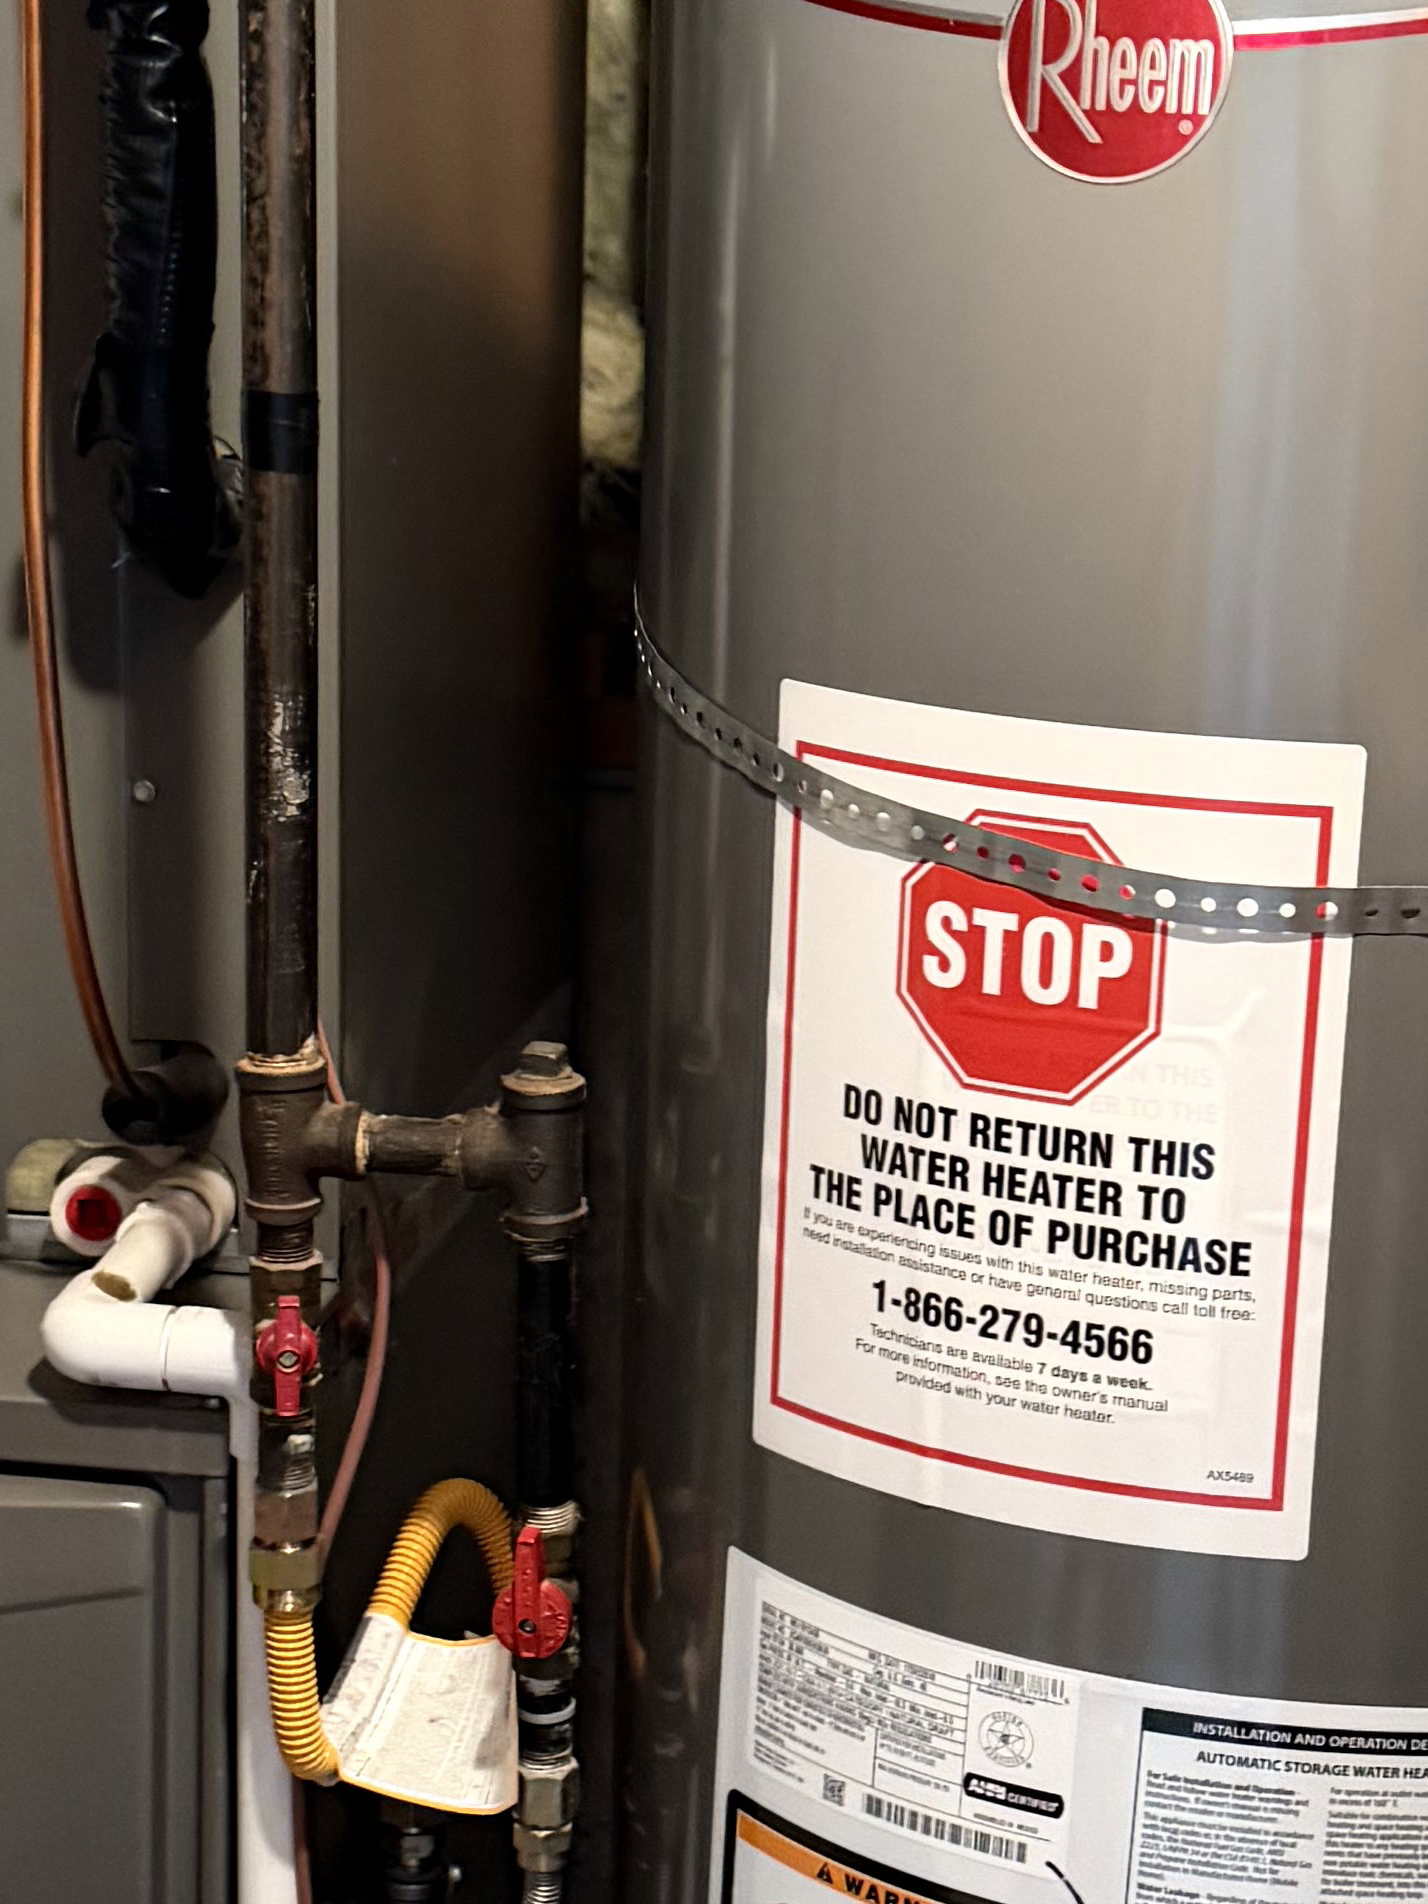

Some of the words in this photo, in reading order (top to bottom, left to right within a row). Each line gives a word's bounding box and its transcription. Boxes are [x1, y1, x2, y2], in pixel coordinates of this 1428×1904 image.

[921, 899, 1133, 1011] STOP
[844, 1084, 882, 1125] DO
[894, 1096, 957, 1142] NOT
[970, 1112, 1113, 1169] RETURN
[1129, 1136, 1214, 1180] THIS
[861, 1134, 969, 1192] WATER
[983, 1162, 1121, 1217] HEATER
[1138, 1185, 1185, 1223] TO
[810, 1164, 861, 1212] THE
[874, 1184, 974, 1239] PLACE
[989, 1210, 1033, 1249] OF
[1048, 1219, 1252, 1277] PURCHASE
[814, 1211, 833, 1226] you
[836, 1219, 854, 1233] are
[858, 1225, 935, 1257] experiencing
[940, 1244, 982, 1264] issues
[986, 1255, 1013, 1270] with
[1018, 1260, 1043, 1276] this
[1049, 1268, 1088, 1283] water
[1149, 1282, 1208, 1300] missing
[833, 1234, 895, 1262] installation
[899, 1255, 966, 1280] assistance
[971, 1272, 984, 1284] or
[989, 1273, 1022, 1291] have
[1027, 1283, 1081, 1301] general
[1085, 1293, 1158, 1312] questions
[1163, 1301, 1188, 1314] call
[1194, 1304, 1215, 1317] toll
[870, 1323, 942, 1354] Technicians
[947, 1346, 968, 1361] are
[972, 1350, 1033, 1373] available
[1037, 1362, 1047, 1374] 7
[1051, 1365, 1088, 1384] days
[1092, 1372, 1101, 1384] a
[872, 1280, 1153, 1364] 1-866-279-4566
[856, 1338, 876, 1354] For
[879, 1347, 910, 1364] more
[995, 1374, 1020, 1388] see
[1025, 1378, 1048, 1394] the
[1112, 1395, 1168, 1412] manual
[896, 1370, 951, 1394] provided
[955, 1386, 982, 1401] with
[986, 1392, 1016, 1409] your
[1021, 1399, 1060, 1415] water
[1193, 1722, 1292, 1744] INSTALLATION
[1294, 1735, 1326, 1746] AND
[1329, 1736, 1407, 1750] OPERATION
[1196, 1751, 1282, 1771] AUTOMATIC
[1284, 1761, 1350, 1776] STORAGE
[1353, 1765, 1400, 1778] WATER
